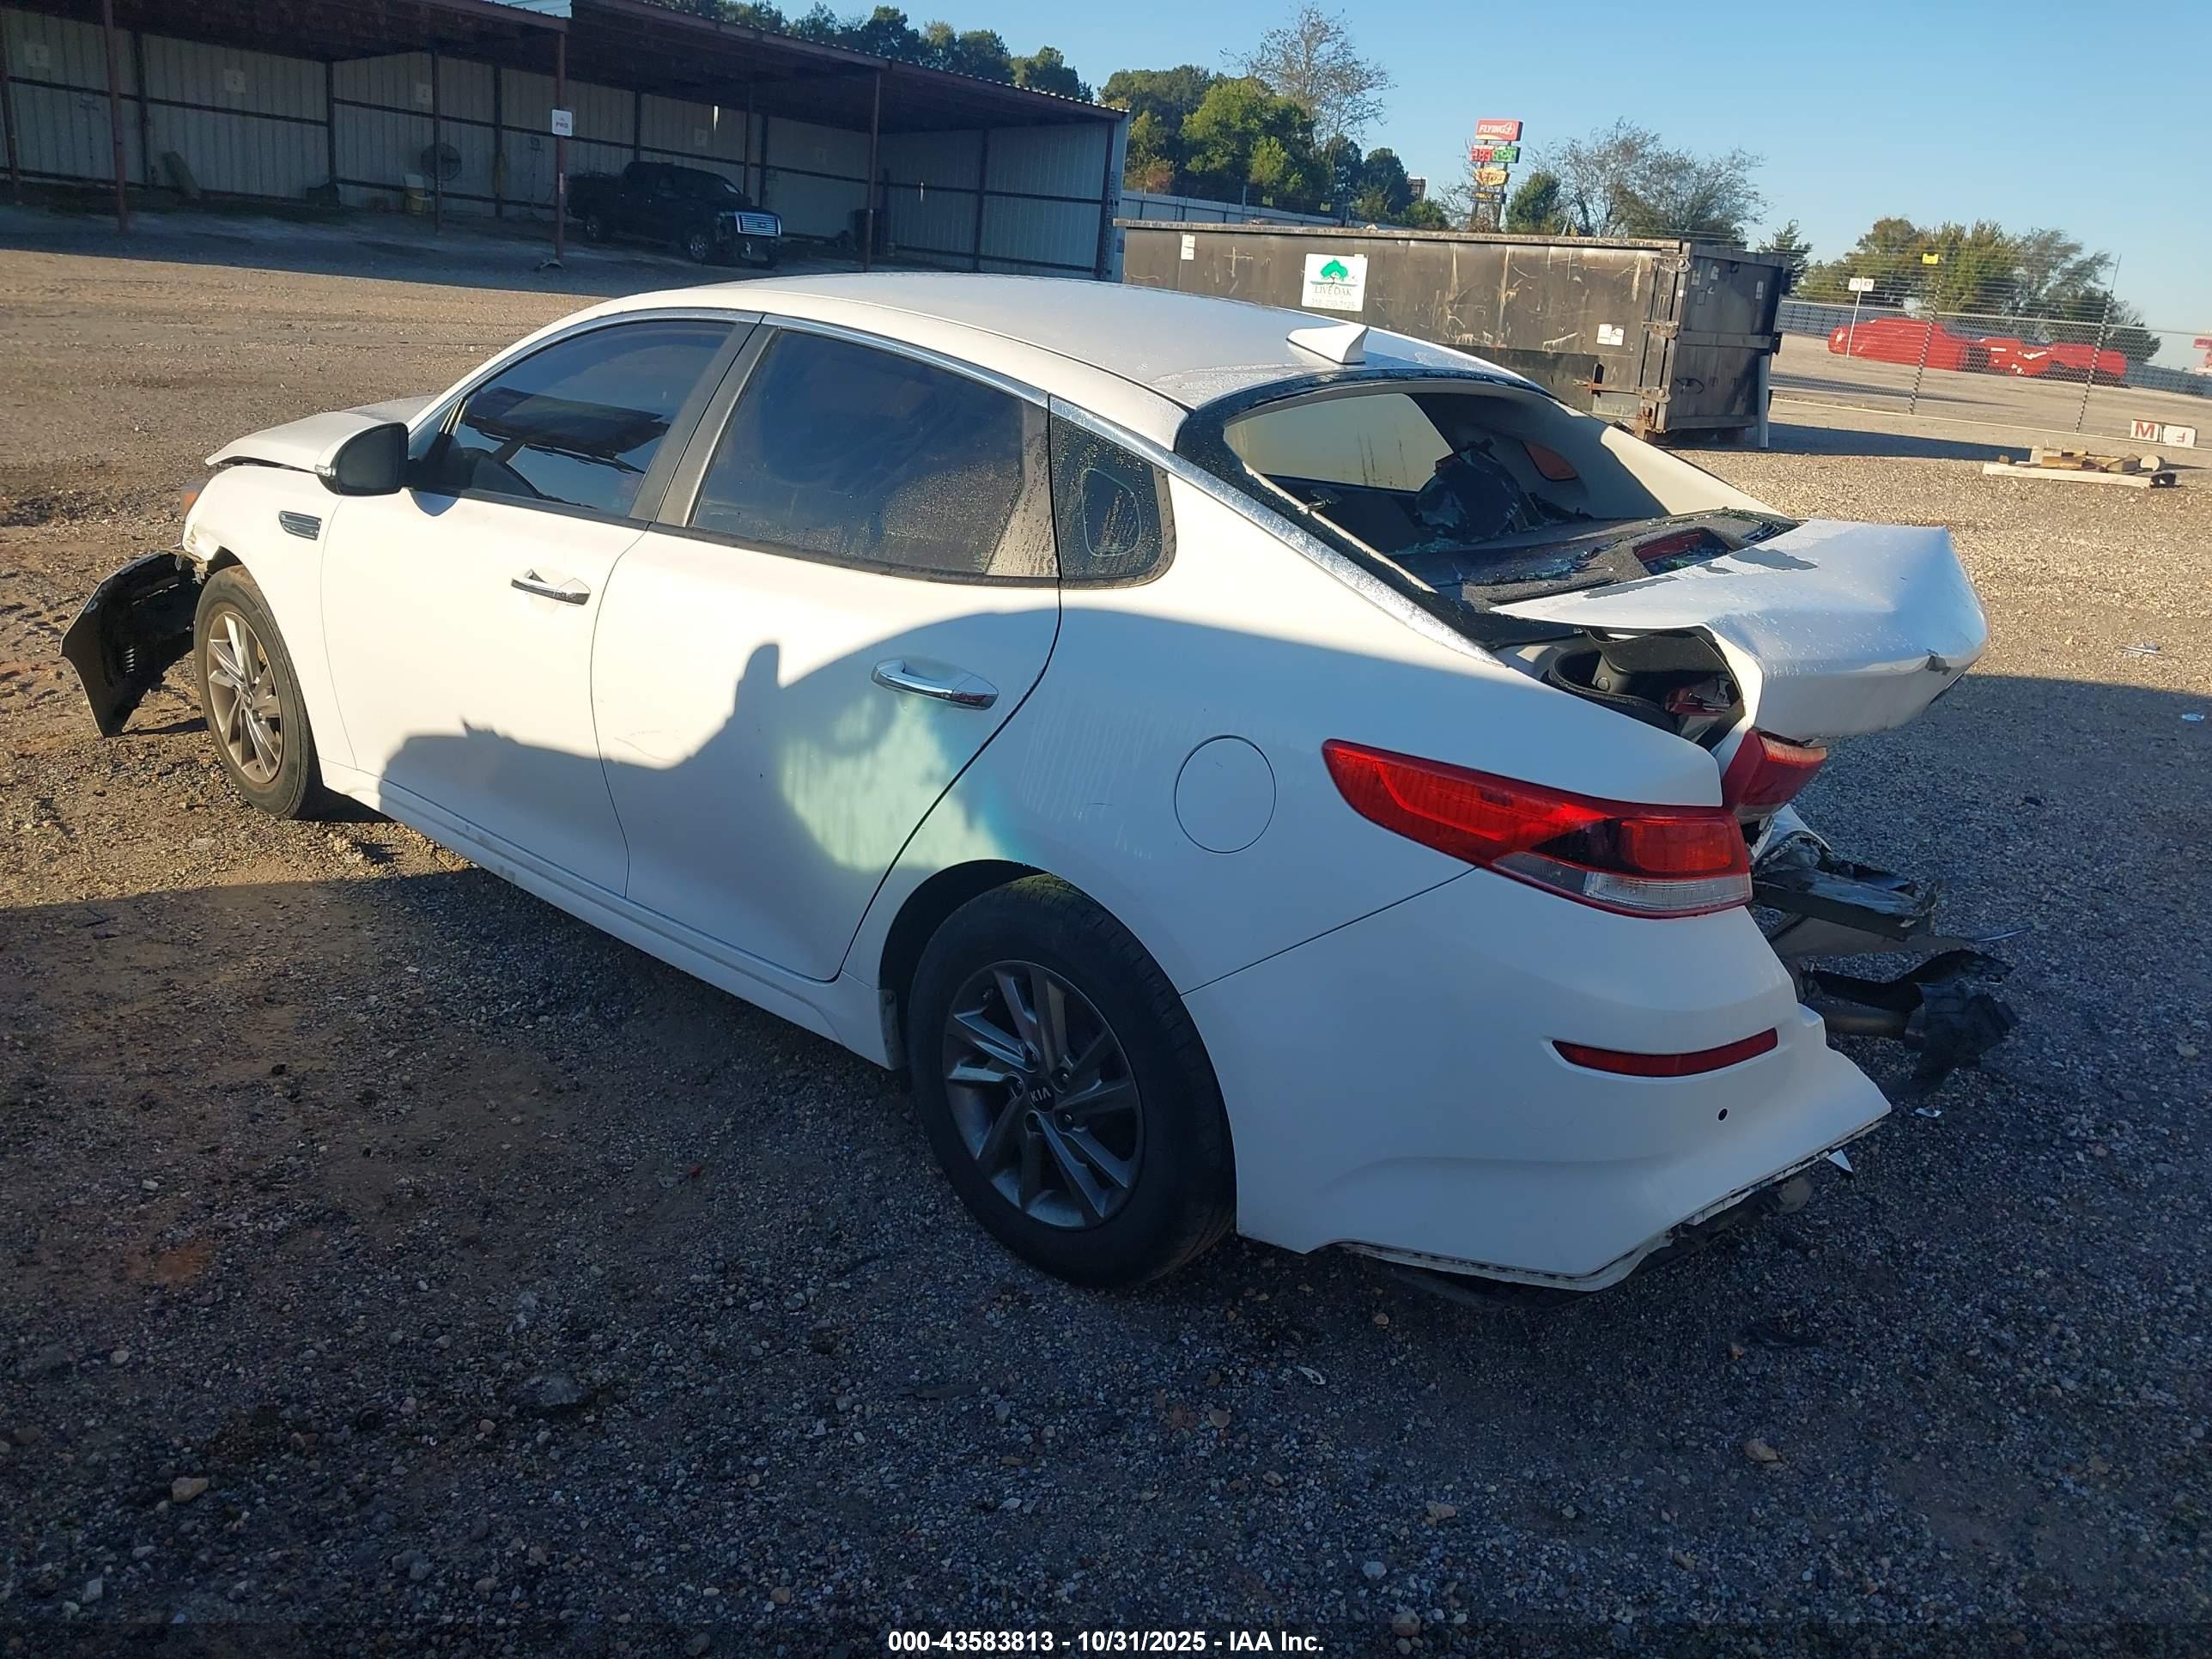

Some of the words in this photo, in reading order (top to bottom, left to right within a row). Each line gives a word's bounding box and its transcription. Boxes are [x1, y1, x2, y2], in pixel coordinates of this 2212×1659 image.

[1479, 124, 1504, 134] FLYING
[1315, 285, 1333, 295] LIVE
[1334, 287, 1352, 296] OAK
[2135, 422, 2155, 439] M
[1030, 1086, 1051, 1103] KIA
